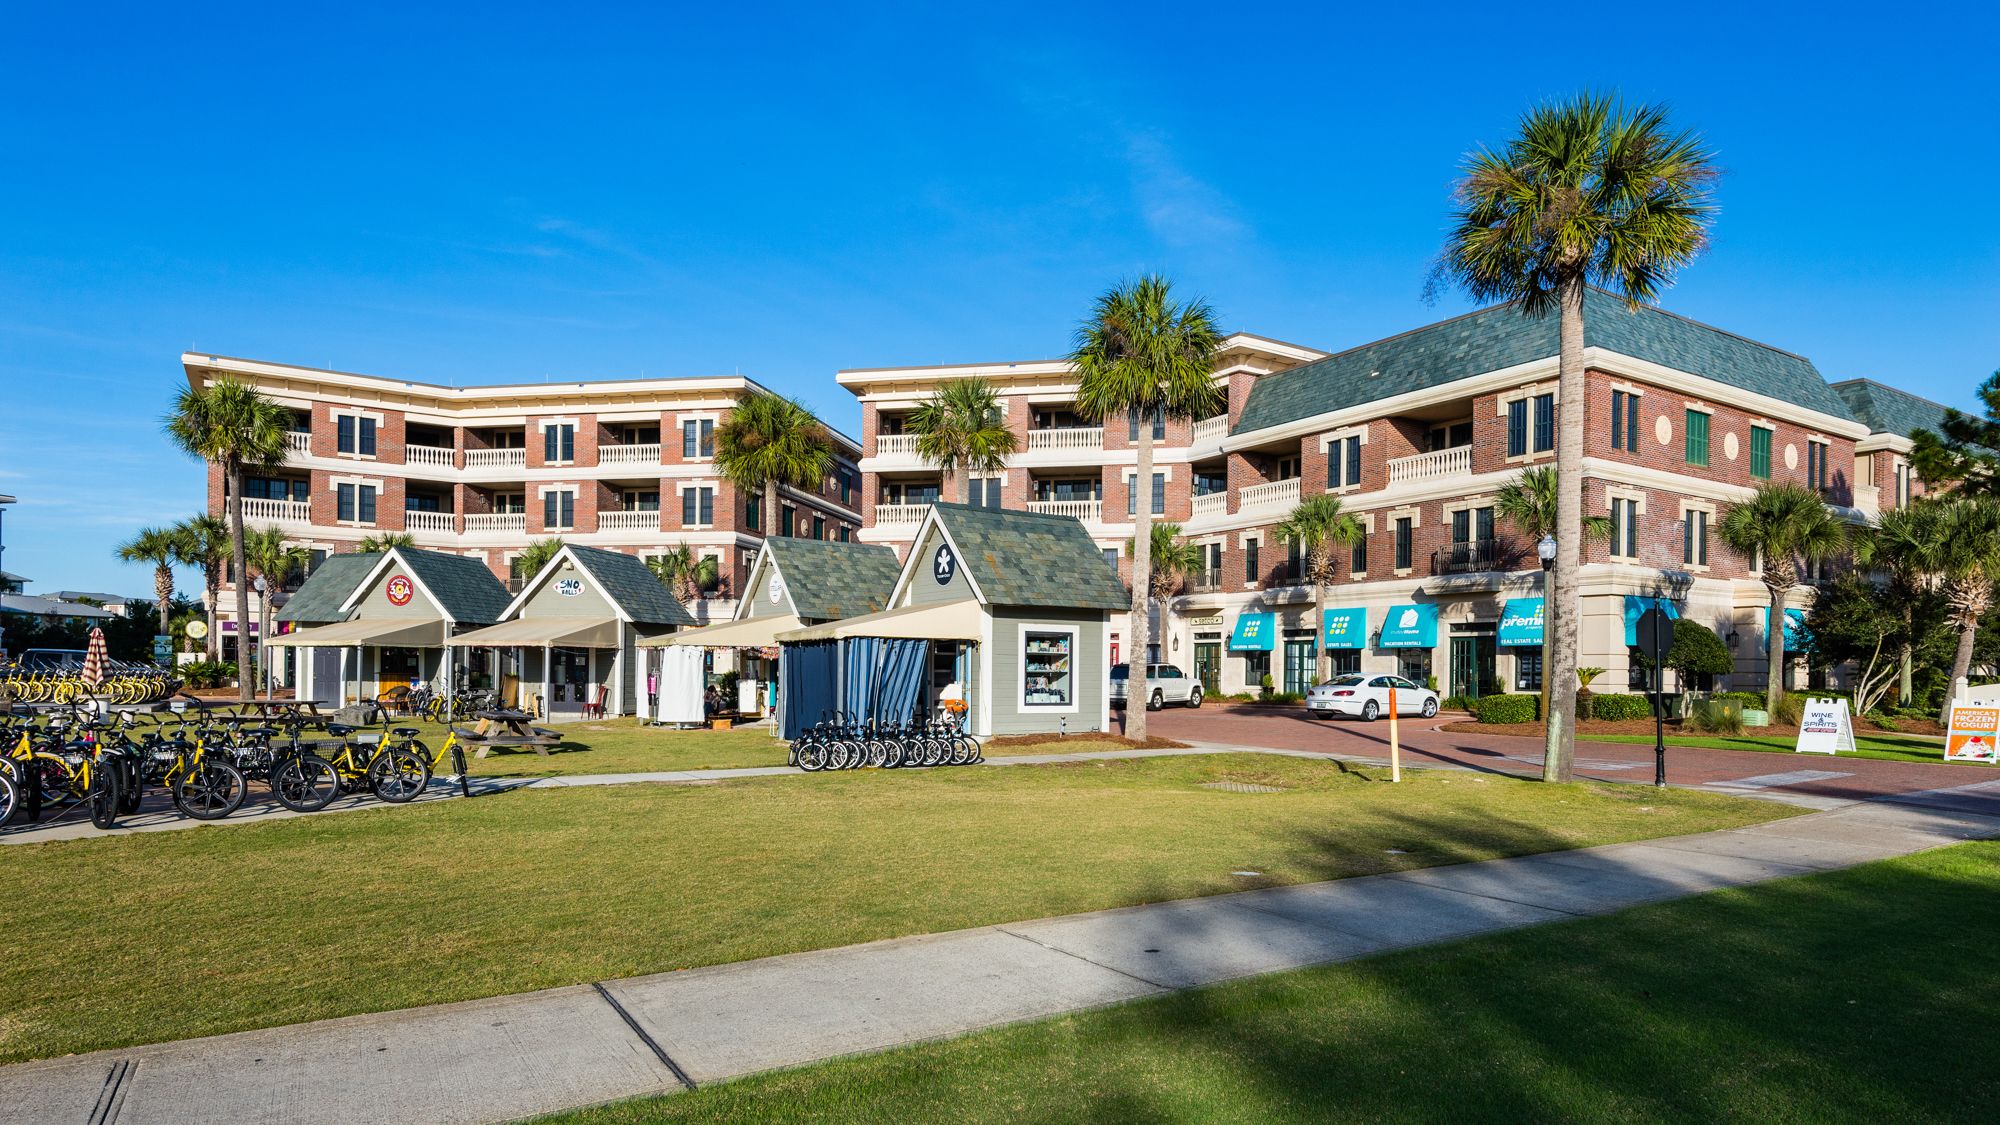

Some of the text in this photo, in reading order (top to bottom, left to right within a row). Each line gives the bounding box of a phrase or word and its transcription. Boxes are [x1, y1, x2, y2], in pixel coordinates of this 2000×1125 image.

[560, 580, 580, 589] SNO
[1501, 617, 1543, 630] premi
[1955, 715, 1997, 723] FROZEN
[1954, 721, 1995, 729] YOGURT
